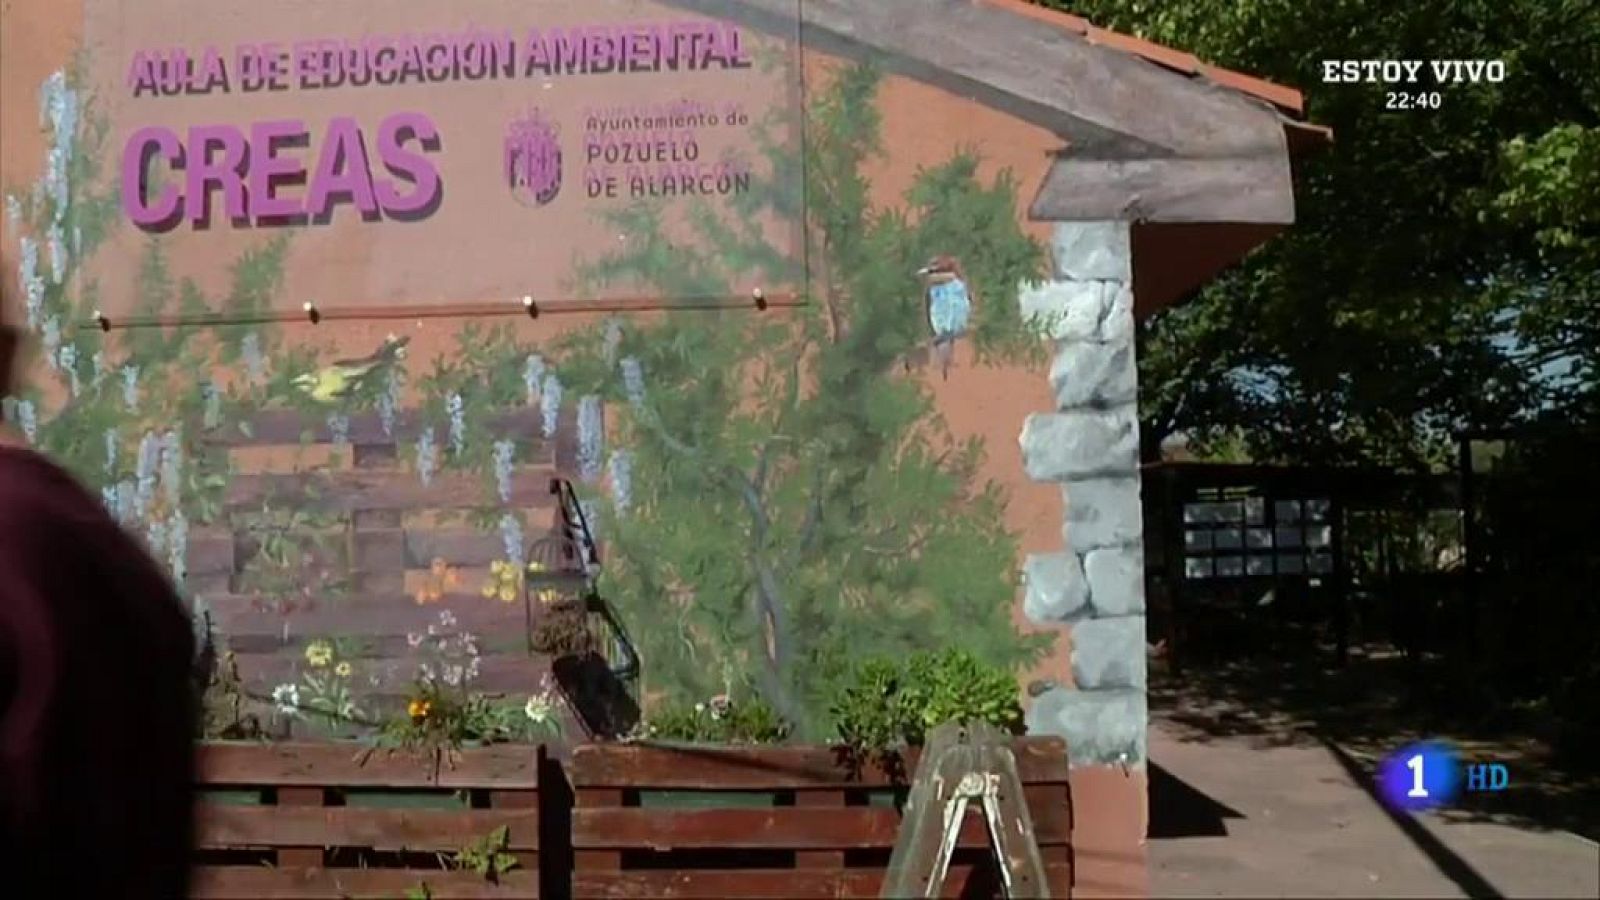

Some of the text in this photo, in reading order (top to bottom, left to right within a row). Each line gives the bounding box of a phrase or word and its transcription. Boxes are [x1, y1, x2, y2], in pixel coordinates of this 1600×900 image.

[129, 21, 752, 97] AULA DE EDUCACIÓN AMBIENTAL
[585, 110, 749, 134] Ayuntamiento de
[586, 140, 699, 164] POZUELO
[122, 112, 442, 233] CREAS
[586, 176, 618, 197] DE
